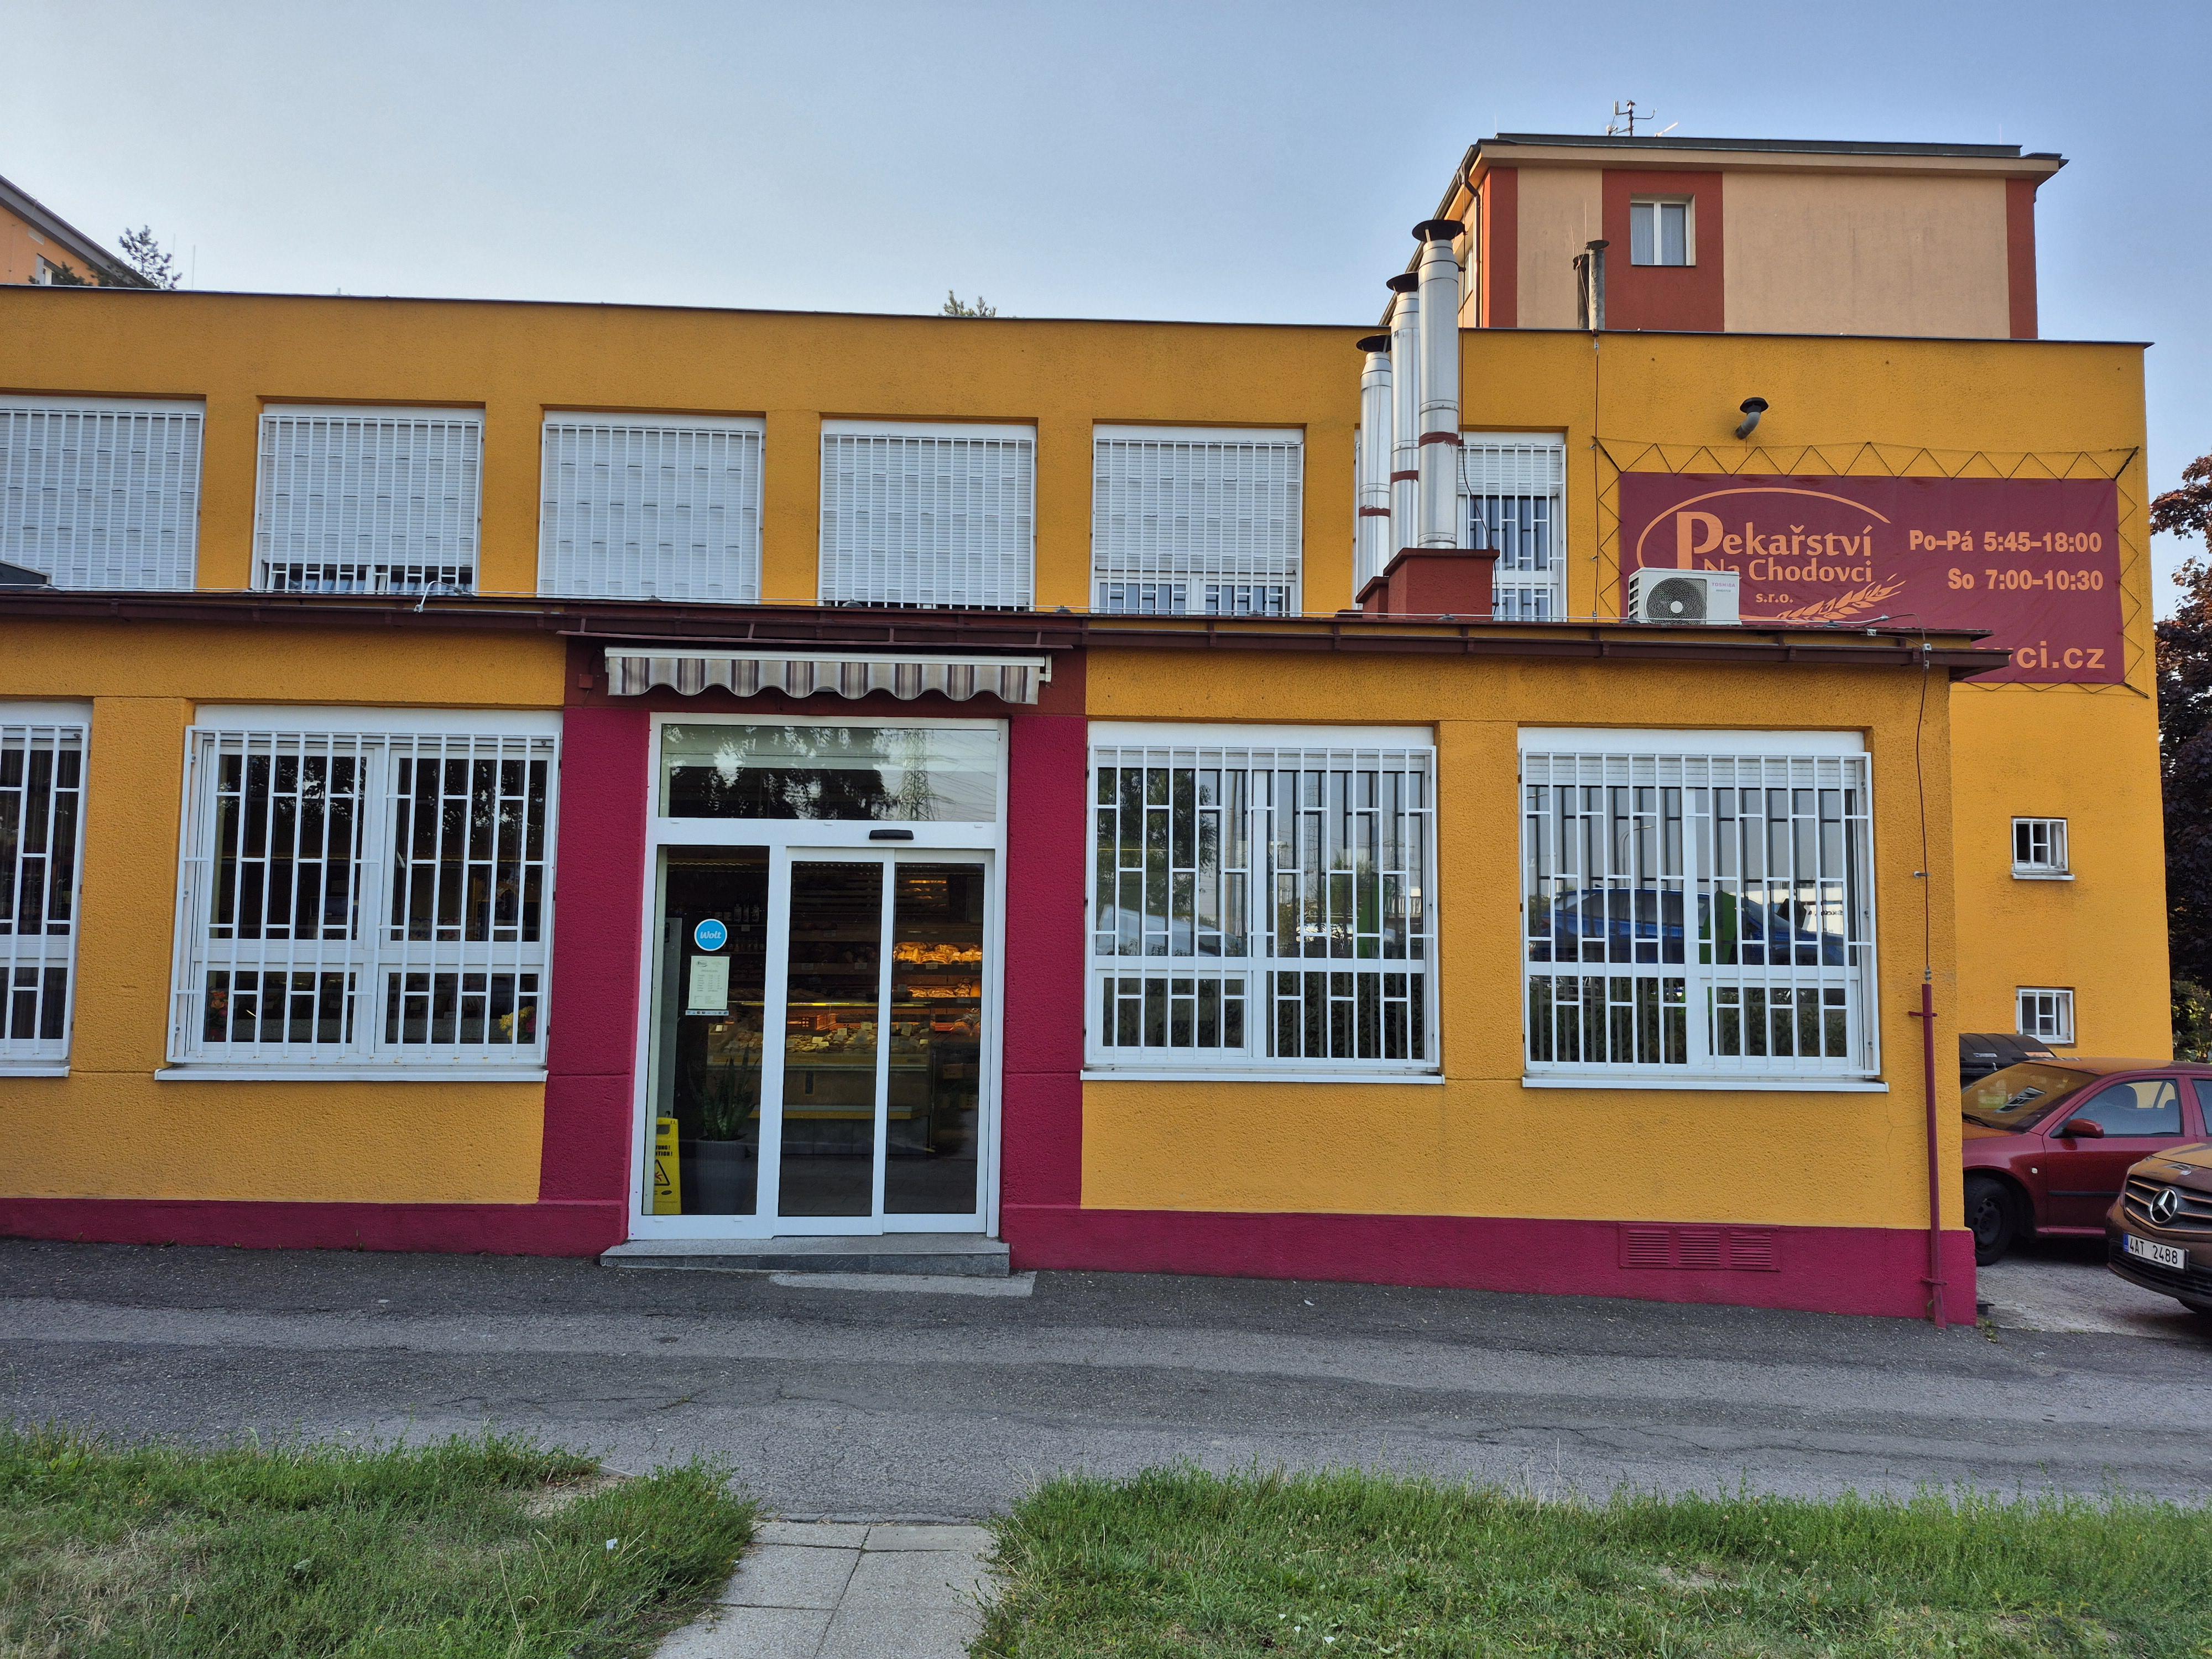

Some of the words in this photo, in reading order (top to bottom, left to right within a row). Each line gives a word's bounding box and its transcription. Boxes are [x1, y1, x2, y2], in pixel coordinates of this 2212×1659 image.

[1677, 512, 1872, 569] Pekařství
[1749, 557, 1872, 582] Chodovci
[1948, 568, 1974, 589] So
[1756, 592, 1793, 603] s.r.o.
[700, 931, 722, 939] Wolt
[2130, 1238, 2145, 1255] 4AT
[2153, 1245, 2178, 1264] 2488
